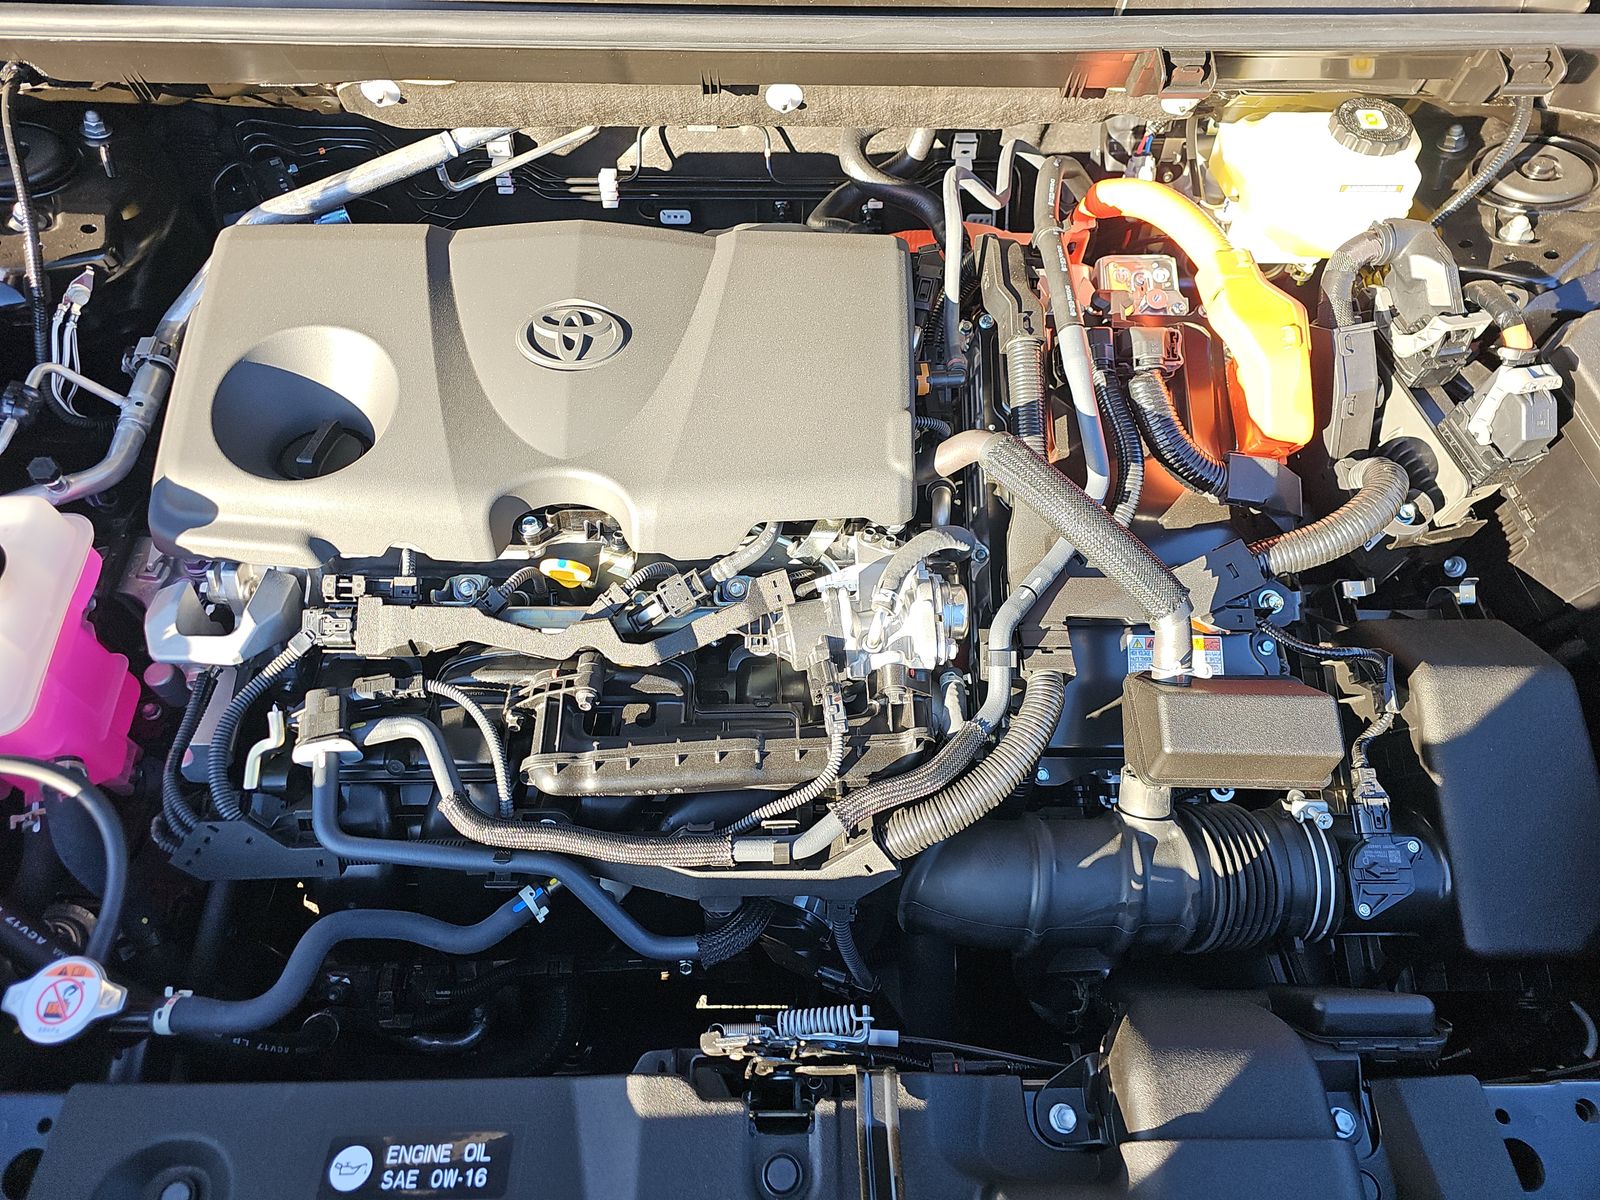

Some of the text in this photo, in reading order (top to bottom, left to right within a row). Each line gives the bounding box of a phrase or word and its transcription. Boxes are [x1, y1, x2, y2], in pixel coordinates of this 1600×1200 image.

[5, 916, 47, 944] ACV17
[386, 1142, 491, 1165] ENGINE OIL
[380, 1167, 488, 1190] SAE 0W-16
